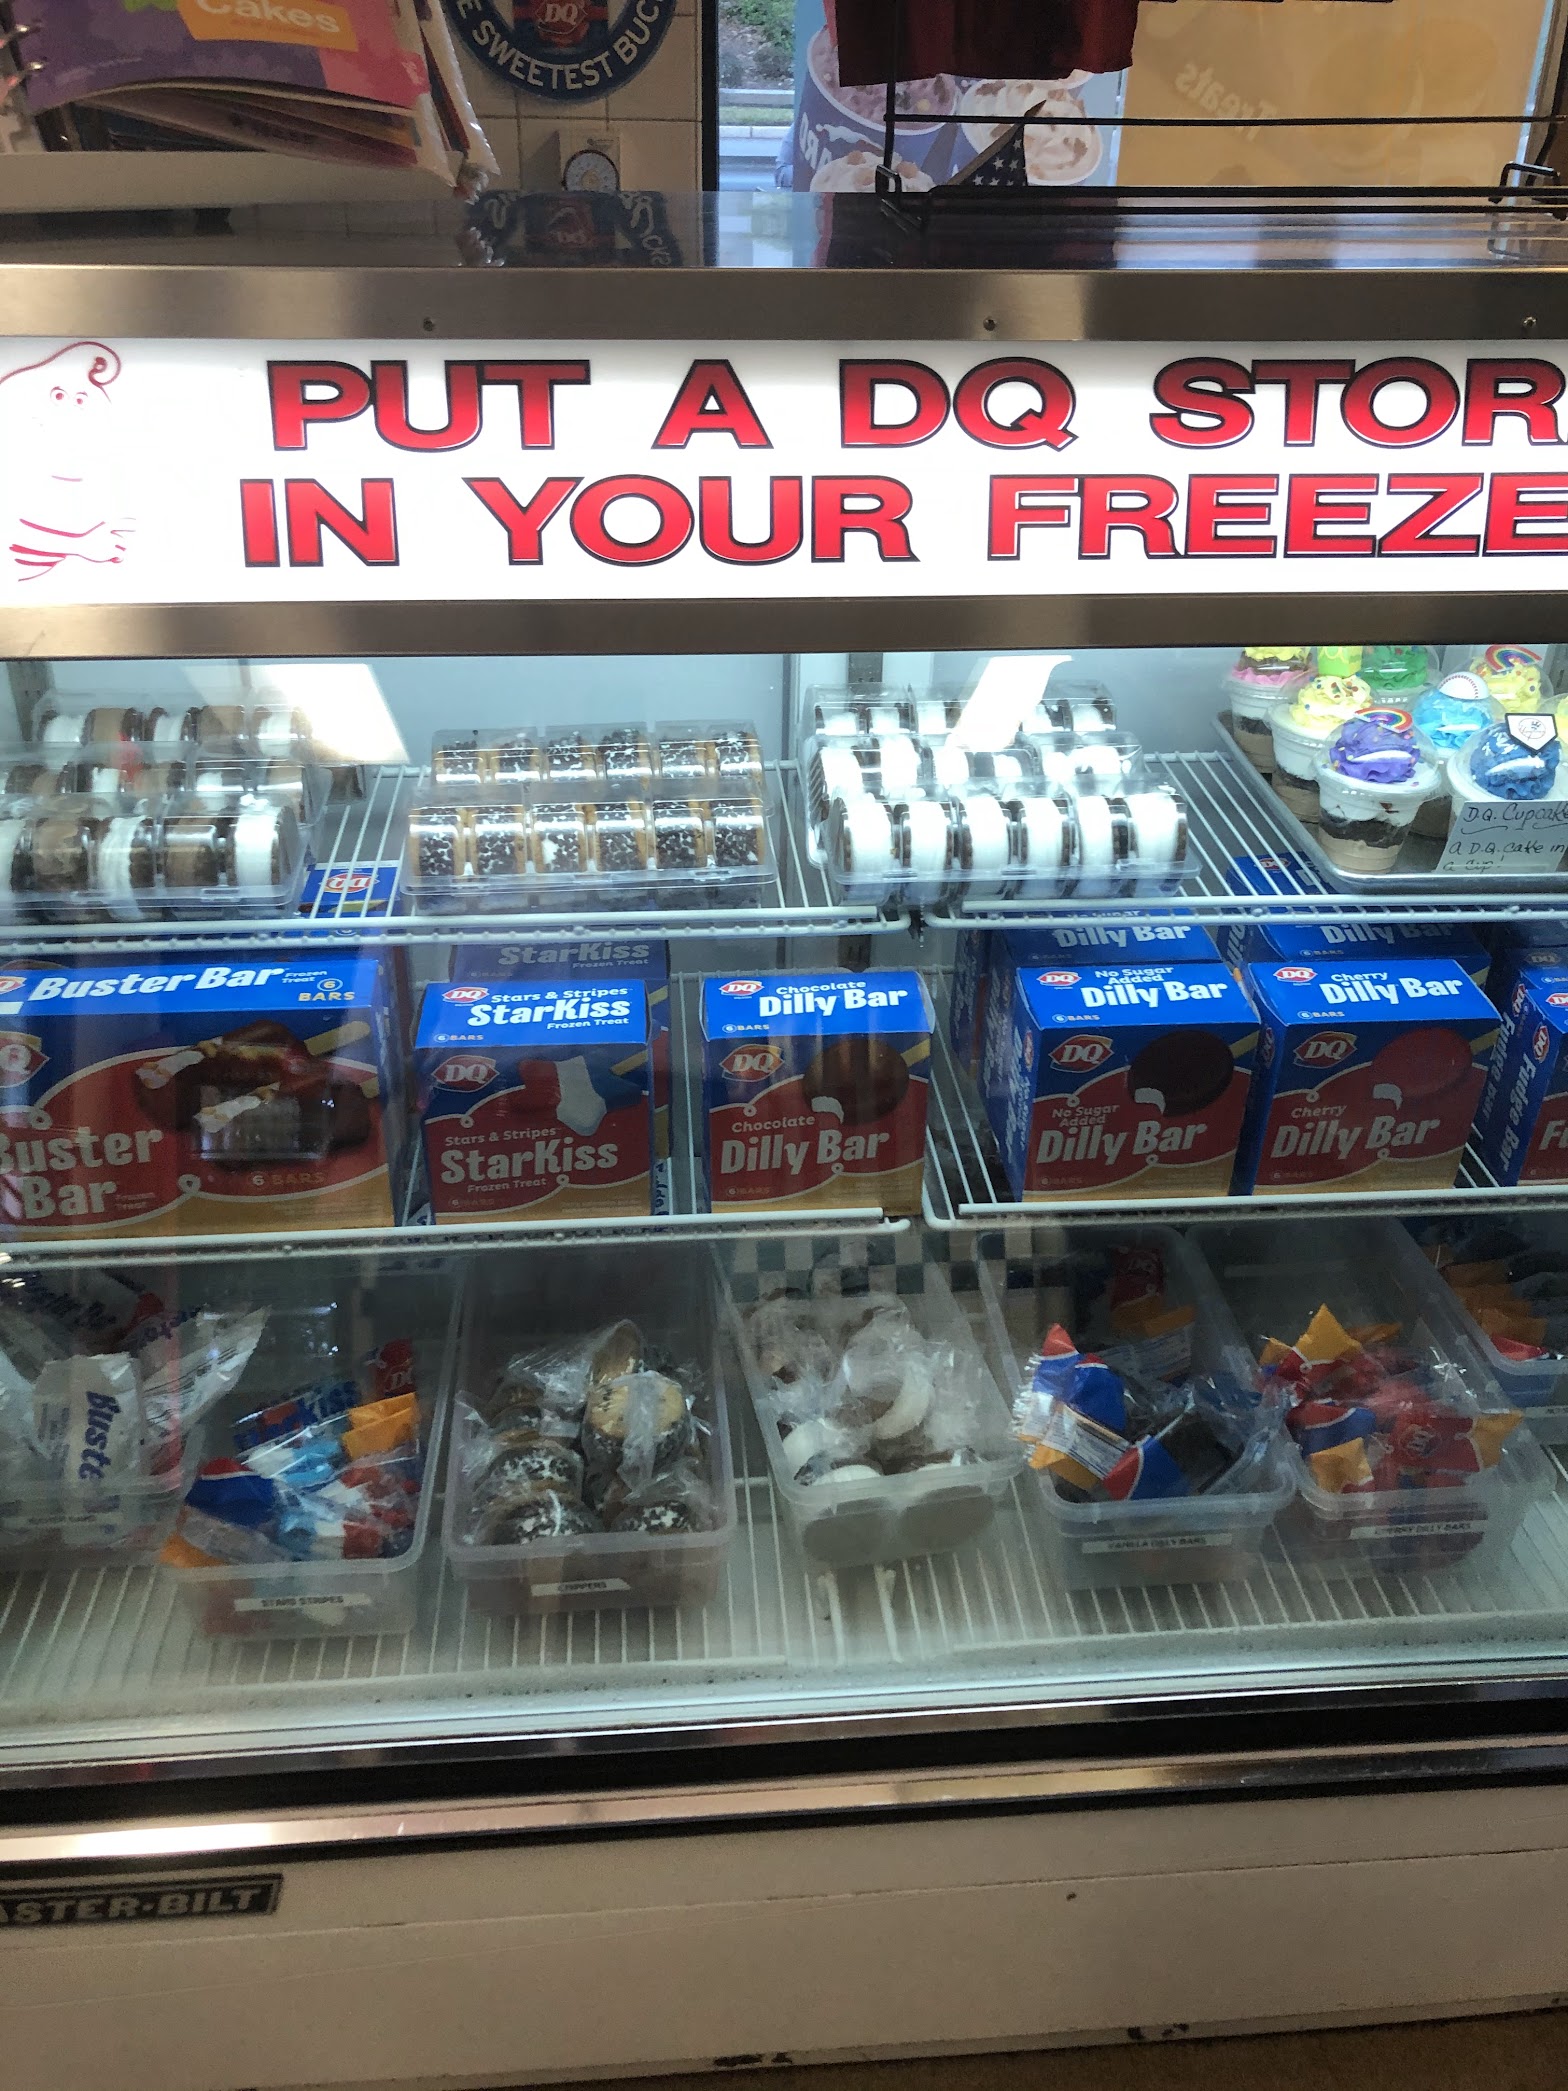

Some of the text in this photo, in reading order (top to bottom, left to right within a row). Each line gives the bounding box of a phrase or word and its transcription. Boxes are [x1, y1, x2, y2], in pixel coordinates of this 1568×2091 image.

[196, 0, 340, 33] Cakes
[544, 4, 578, 25] DQ
[472, 20, 613, 90] SWEETEST
[613, 0, 662, 66] BUC
[266, 356, 1568, 452] PUT A DQ STOR
[240, 473, 1568, 568] IN YOUR FREEZE
[1132, 925, 1191, 942] Bar
[1319, 924, 1396, 944] Dilly
[498, 942, 649, 966] StarKiss
[284, 970, 328, 978] Frozen
[1045, 973, 1074, 983] DQ
[1095, 967, 1174, 978] No Sugar
[1108, 974, 1164, 985] Added
[1281, 970, 1311, 980] DQ
[1330, 972, 1389, 984] Cherry
[28, 973, 197, 1001] Buster
[193, 967, 286, 990] Bar
[728, 983, 757, 993] DQ
[776, 982, 867, 995] Chocolate
[1319, 977, 1464, 1005] Dilly Bar
[298, 991, 356, 1002] BARS
[450, 989, 484, 1000] DQ
[491, 987, 628, 1003] Stars & Stripes
[759, 989, 909, 1017] Dilly Bar
[1080, 981, 1228, 1008] Dilly Bar
[467, 998, 631, 1027] StarKiss
[1312, 1010, 1346, 1018] BARS
[547, 1017, 629, 1030] Frozen Treat
[1060, 1043, 1101, 1063] DQ
[1303, 1040, 1348, 1059] DQ
[731, 1052, 775, 1074] DQ
[444, 1063, 488, 1084] DQ
[1509, 1053, 1537, 1126] Fudge
[1052, 1104, 1120, 1118] No Sugar
[1290, 1104, 1348, 1119] Cherry
[731, 1115, 816, 1133] Chocolate
[1058, 1115, 1107, 1127] Added
[445, 1127, 557, 1146] Stars & Stripes
[1036, 1121, 1208, 1166] Dilly Bar
[1270, 1115, 1441, 1159] Dilly Bar
[440, 1137, 619, 1184] StarKiss
[720, 1129, 890, 1175] Dilly Bar
[252, 1174, 265, 1186] 6
[467, 1178, 547, 1194] Frozen Treat
[21, 1176, 118, 1220] Bar
[78, 1390, 121, 1480] Buste
